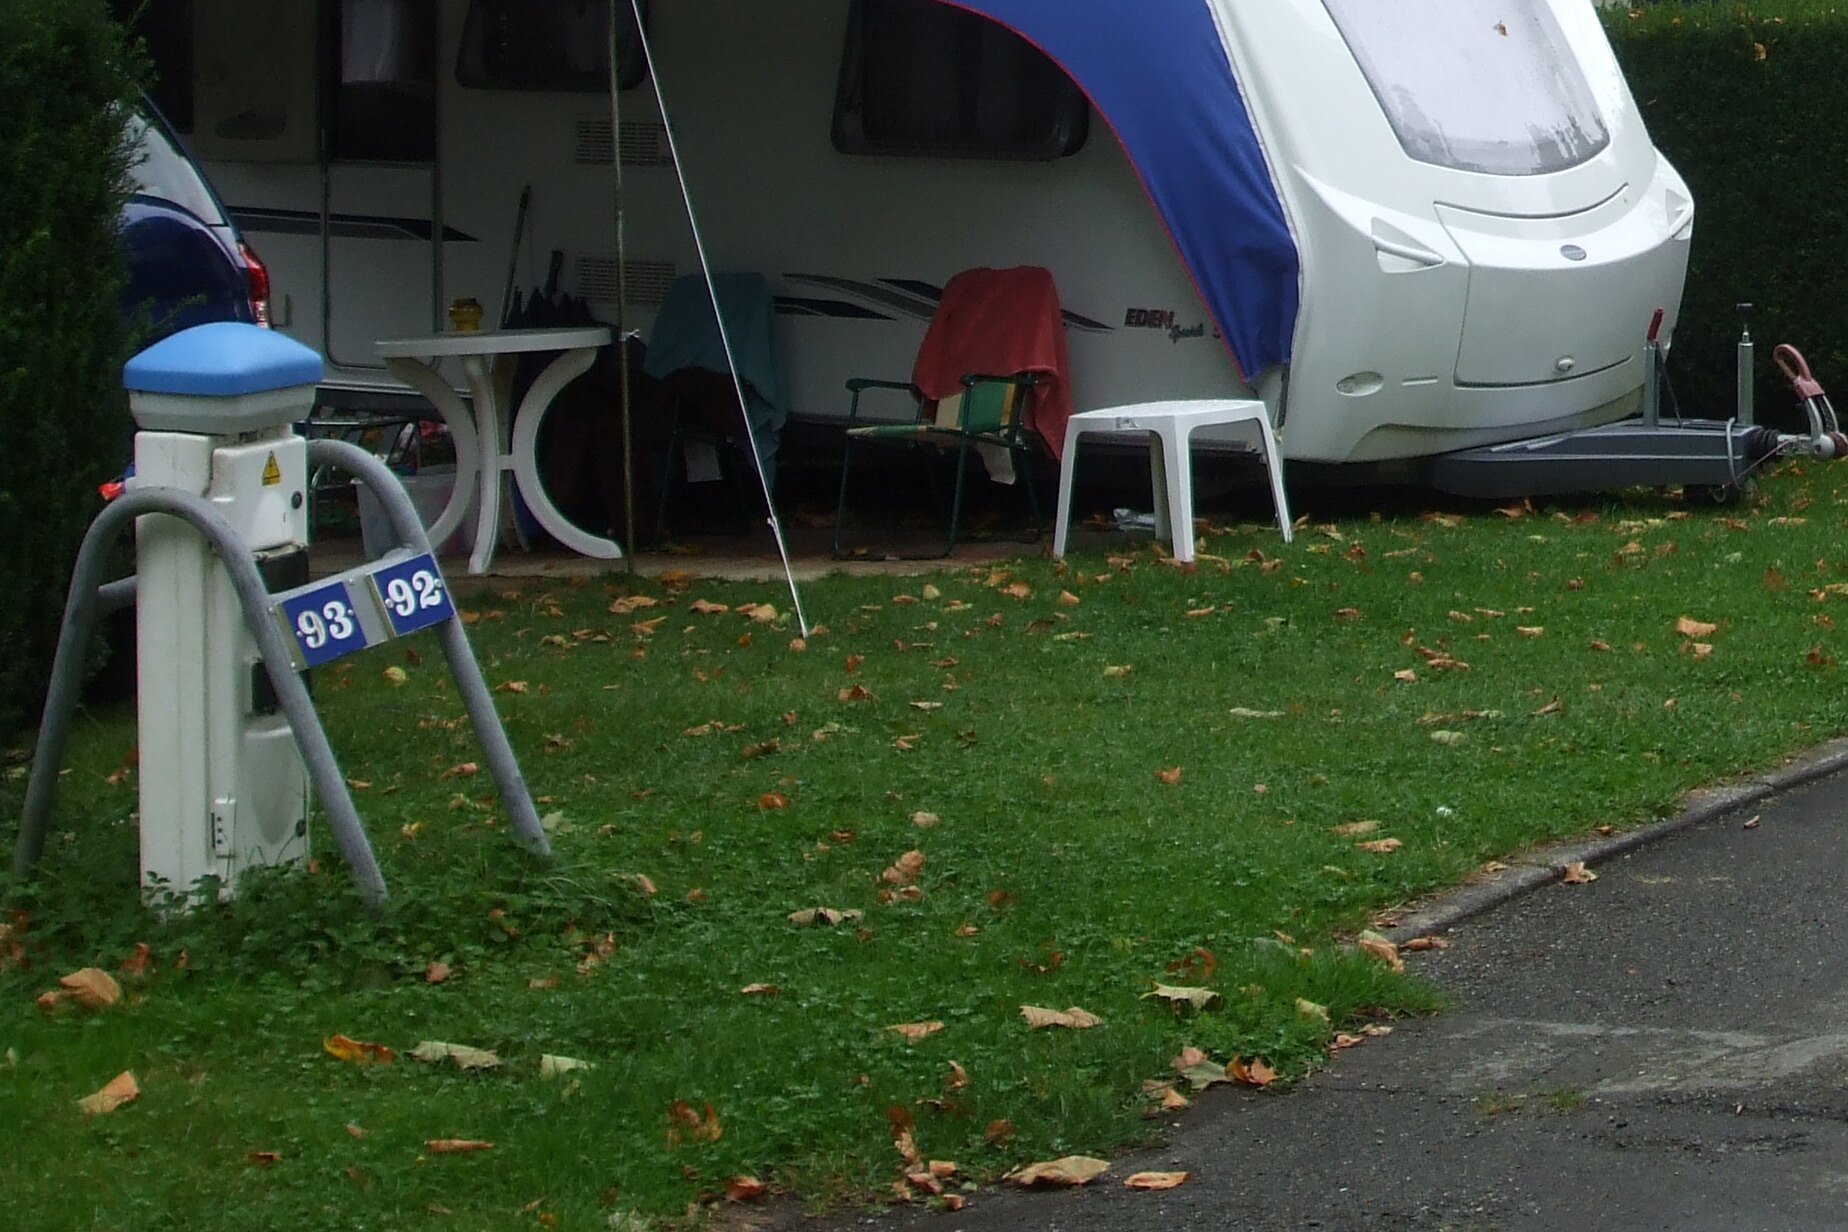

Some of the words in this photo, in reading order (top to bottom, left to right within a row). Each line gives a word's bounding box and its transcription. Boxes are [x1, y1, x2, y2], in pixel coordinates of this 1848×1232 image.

[1124, 308, 1175, 330] EDEN
[386, 569, 443, 617] 92
[296, 600, 353, 650] 93
